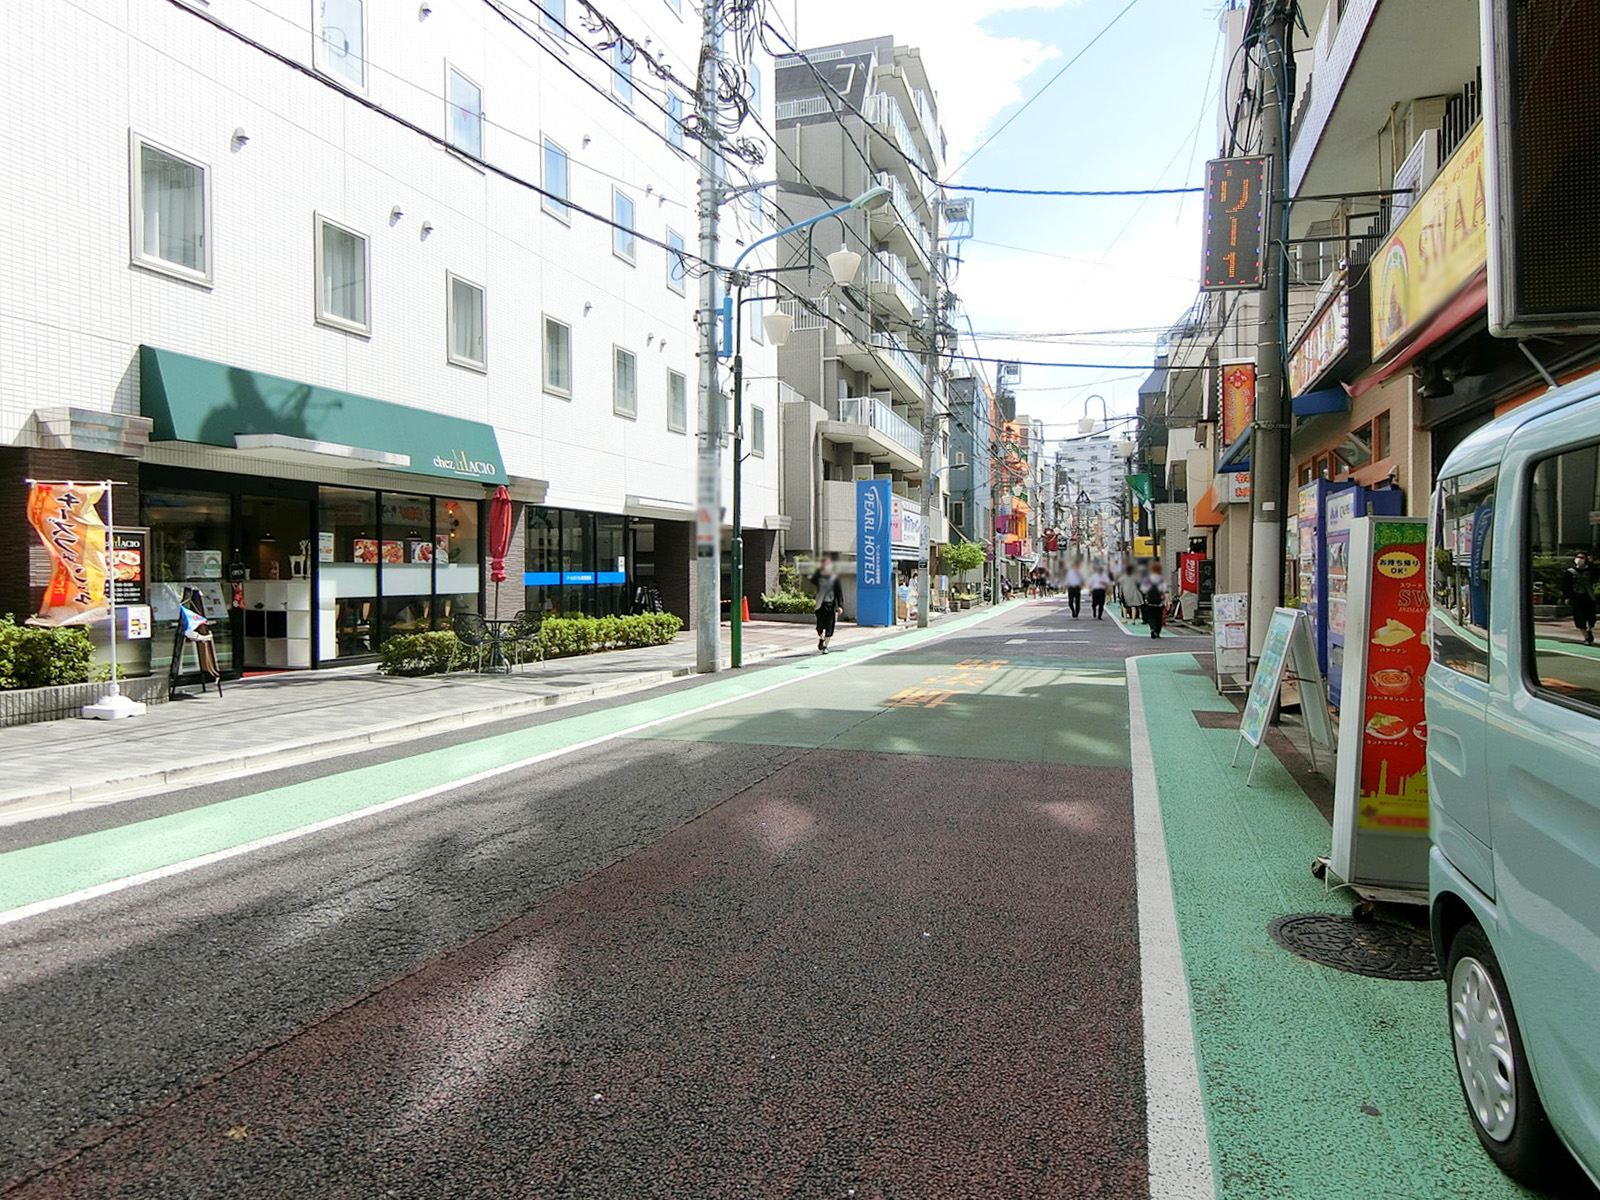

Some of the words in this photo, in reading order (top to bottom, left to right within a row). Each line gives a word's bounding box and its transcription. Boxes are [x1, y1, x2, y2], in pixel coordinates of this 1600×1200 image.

[433, 455, 455, 470] chez
[864, 493, 875, 534] PEARL
[864, 535, 876, 584] HOTELS
[1380, 559, 1419, 567] お持ち帰り
